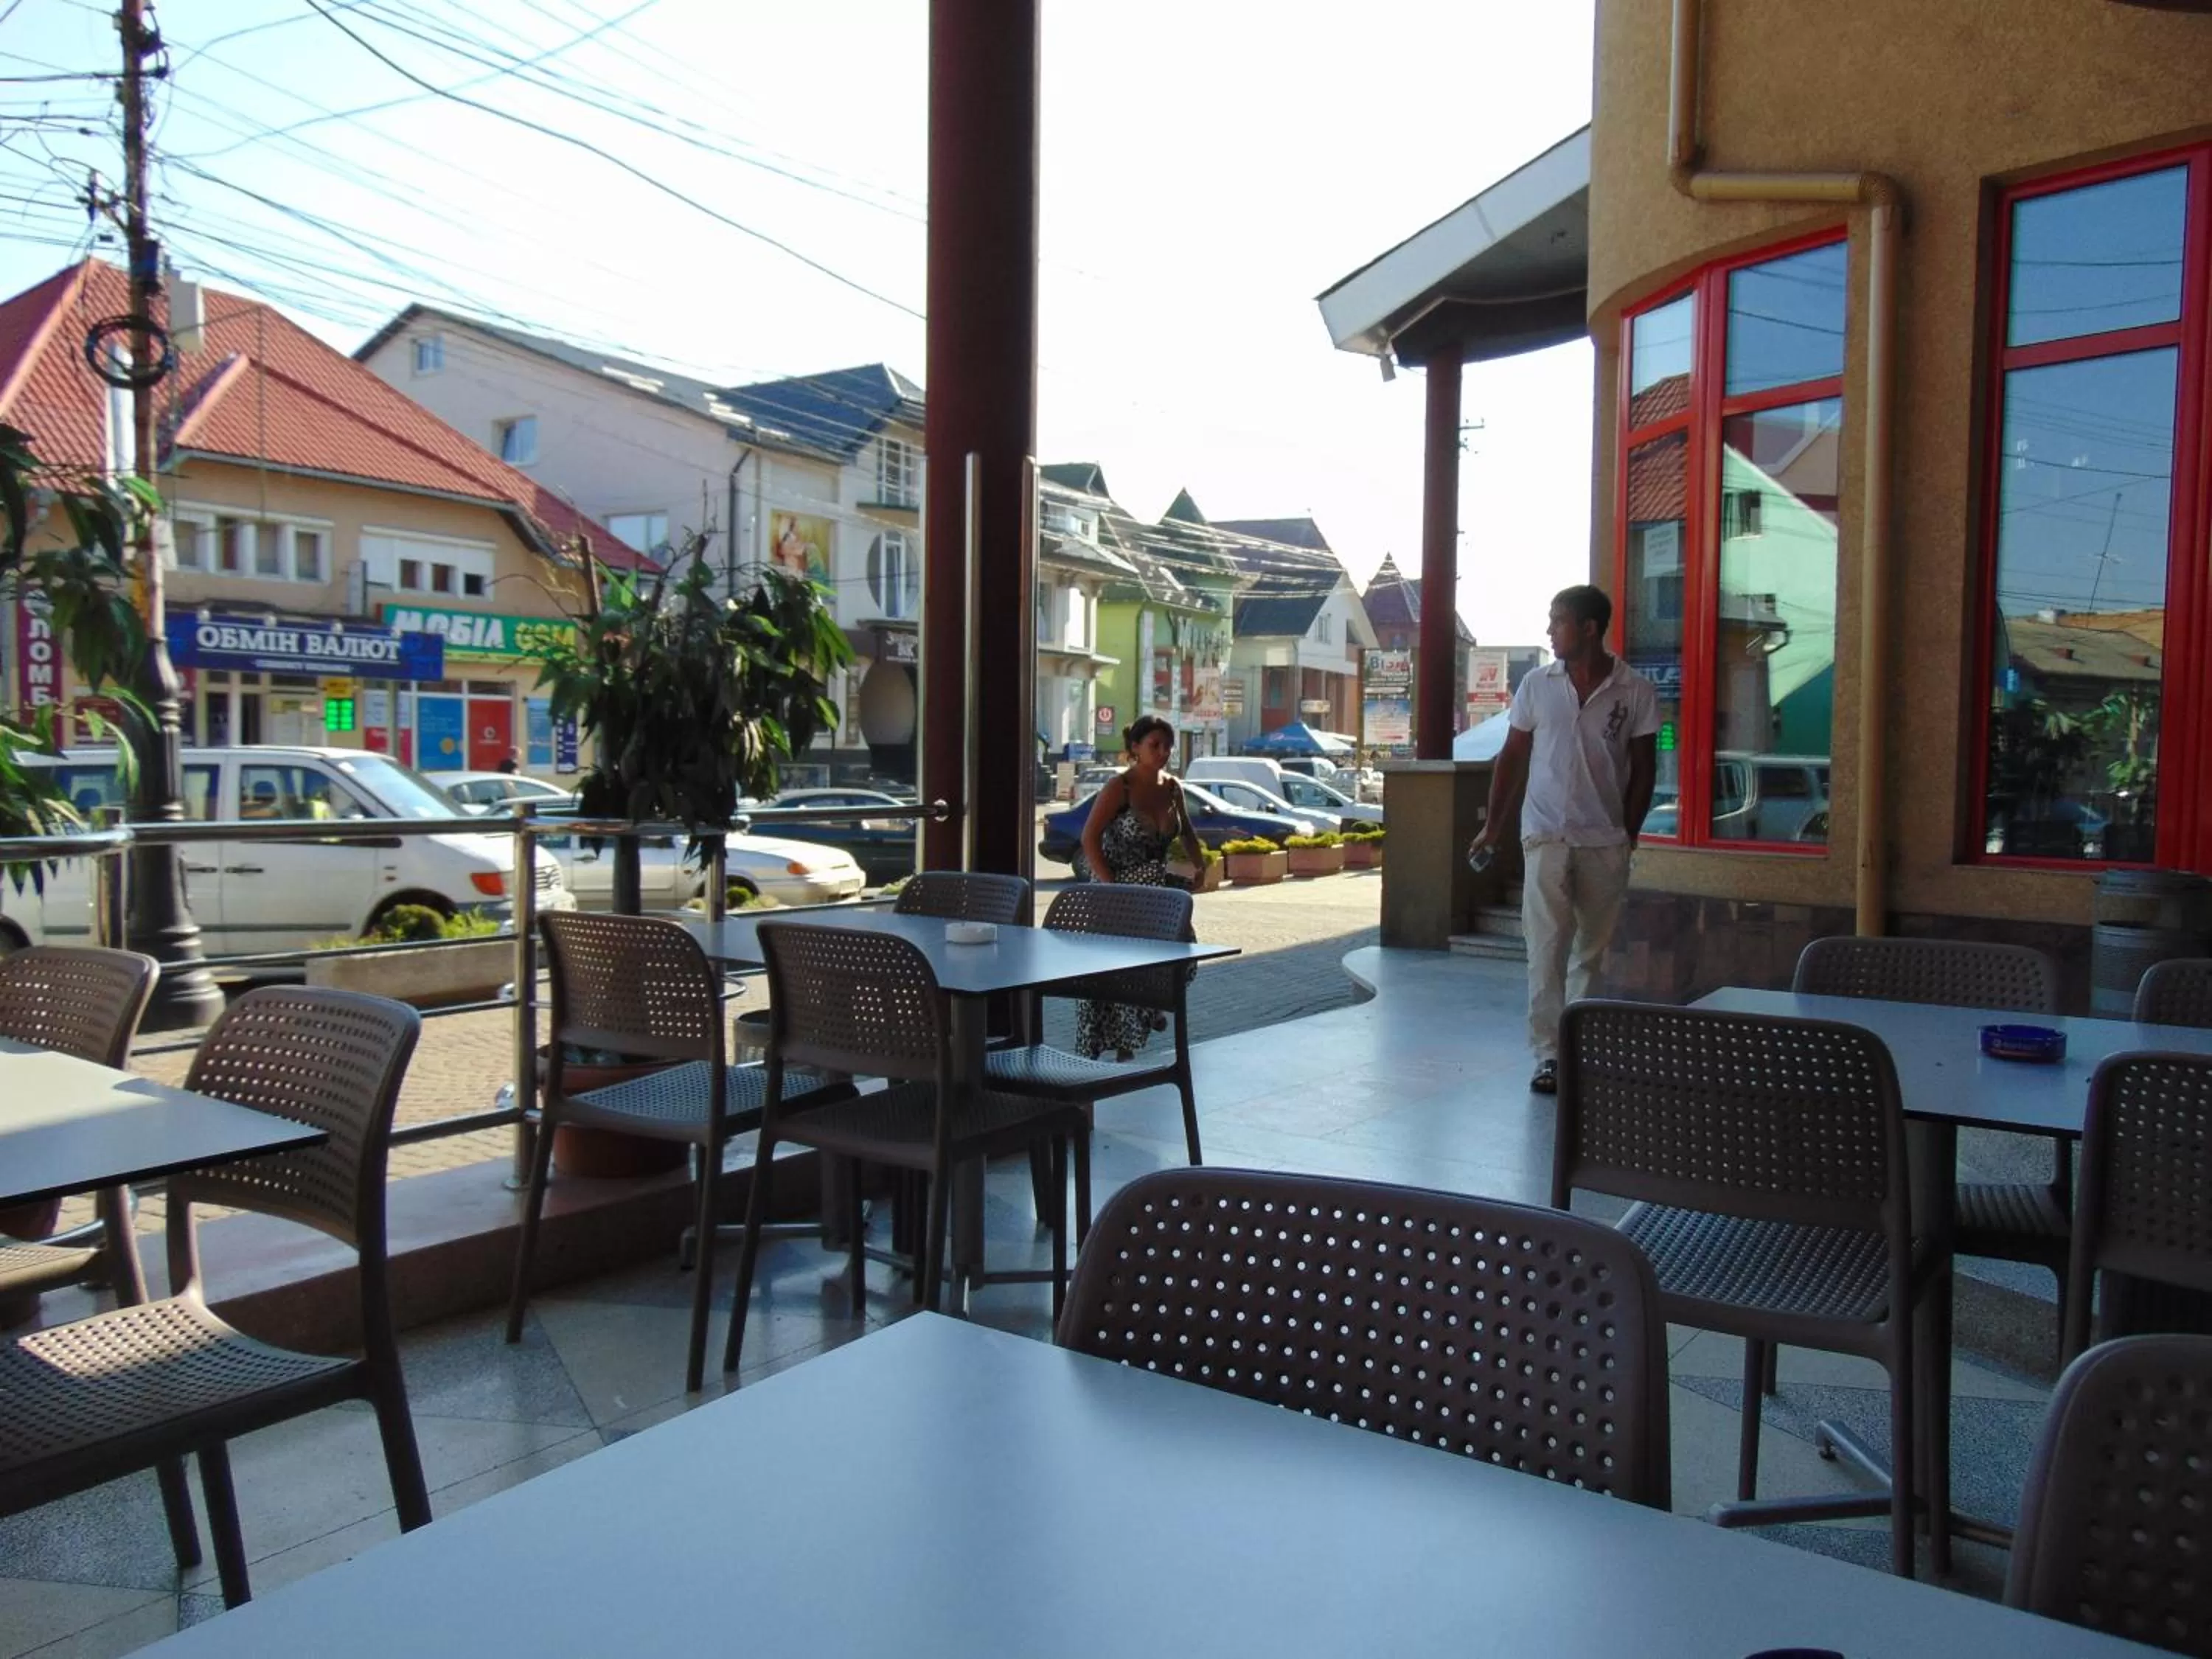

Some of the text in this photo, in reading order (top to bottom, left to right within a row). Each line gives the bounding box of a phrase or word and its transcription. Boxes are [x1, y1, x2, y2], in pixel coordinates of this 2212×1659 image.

[27, 618, 54, 706] ЛОМБ
[196, 625, 401, 660] ОБМІН ВАЛЮТ
